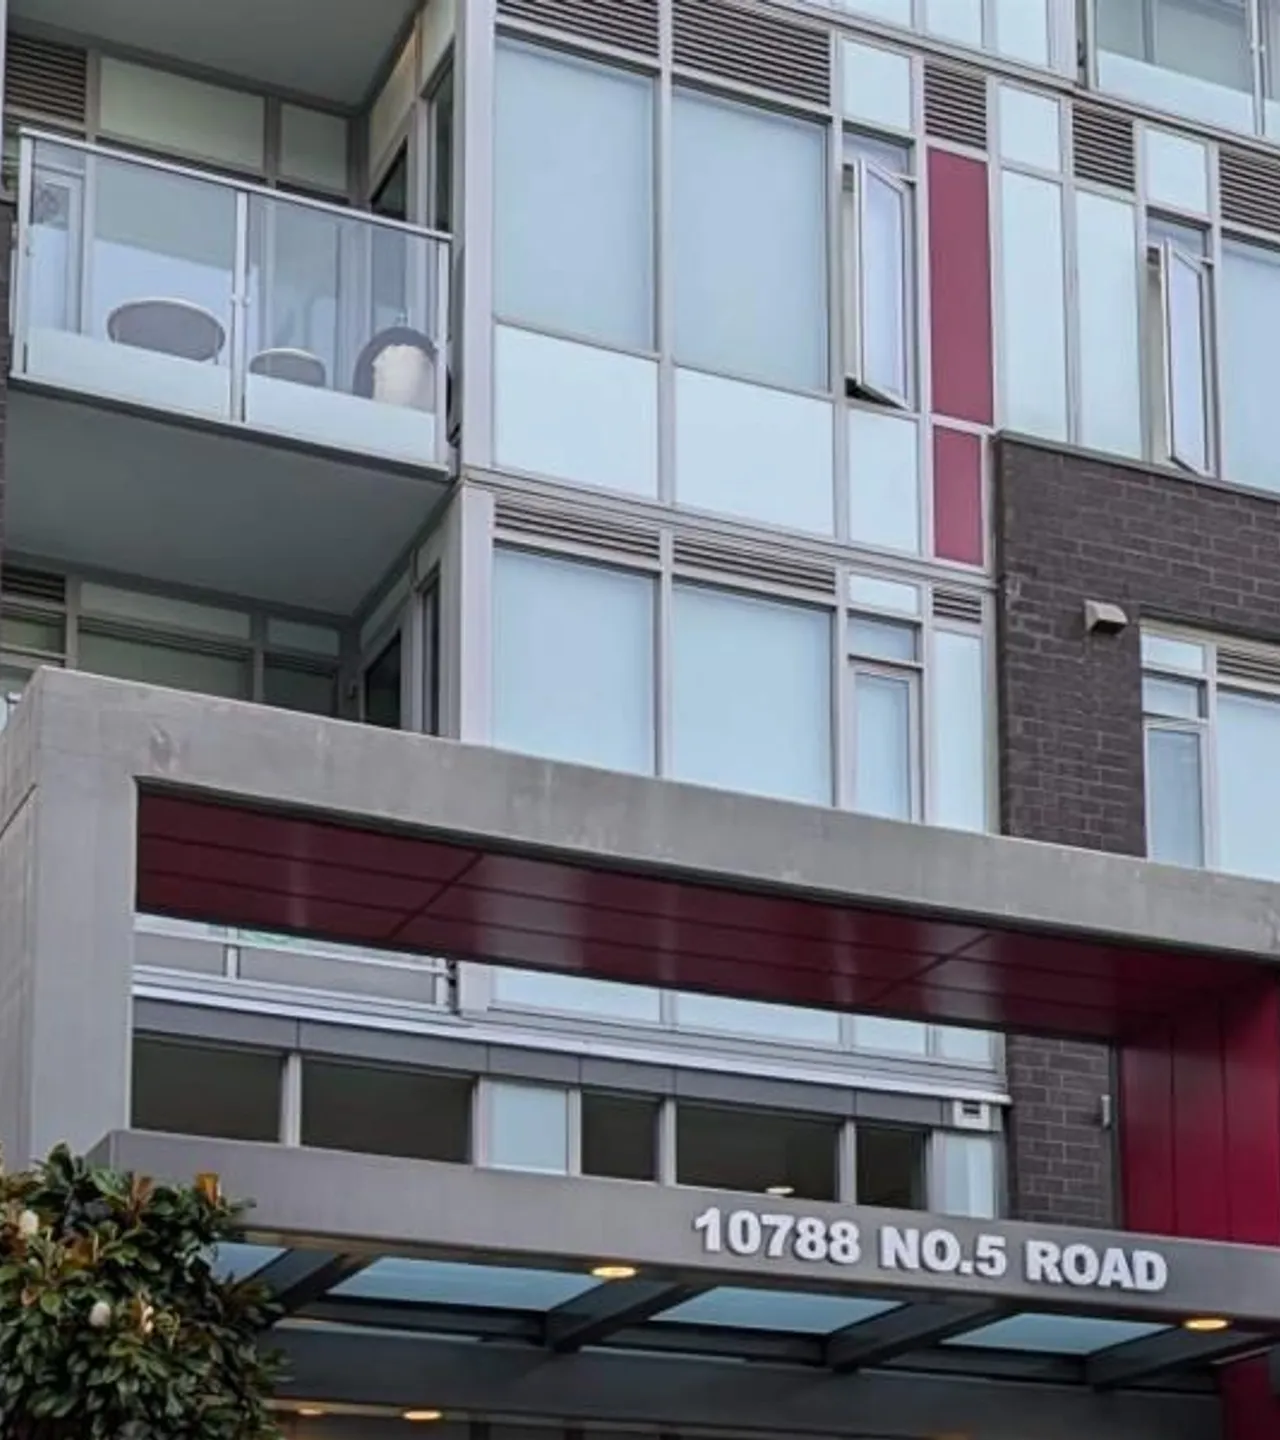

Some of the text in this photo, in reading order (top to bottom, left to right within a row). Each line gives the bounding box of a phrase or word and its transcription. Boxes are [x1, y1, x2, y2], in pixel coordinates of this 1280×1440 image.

[694, 1206, 1168, 1291] 10788 NO.5 ROAD
